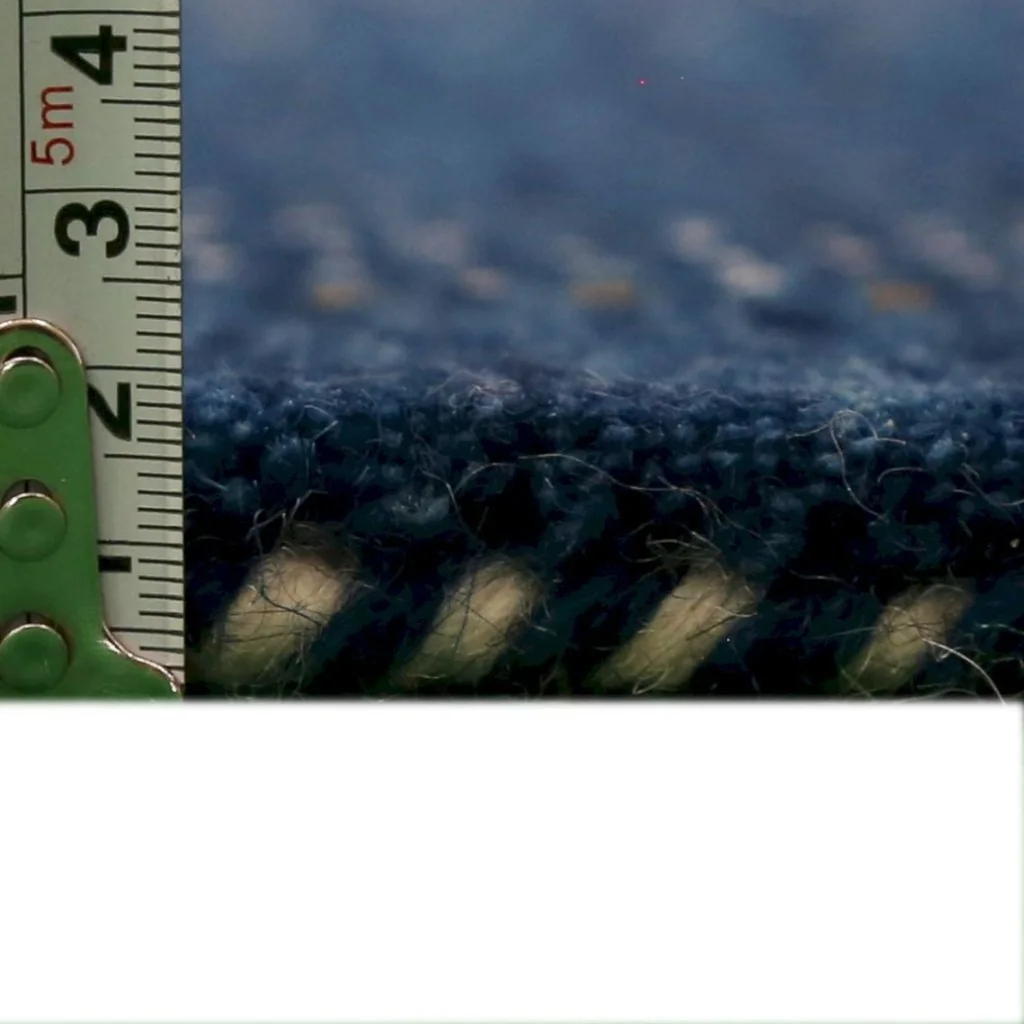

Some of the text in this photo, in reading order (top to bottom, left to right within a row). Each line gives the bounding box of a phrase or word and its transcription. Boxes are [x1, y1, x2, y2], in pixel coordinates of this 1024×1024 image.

[50, 24, 127, 86] 4
[31, 85, 74, 166] 5m
[54, 199, 130, 258] 3
